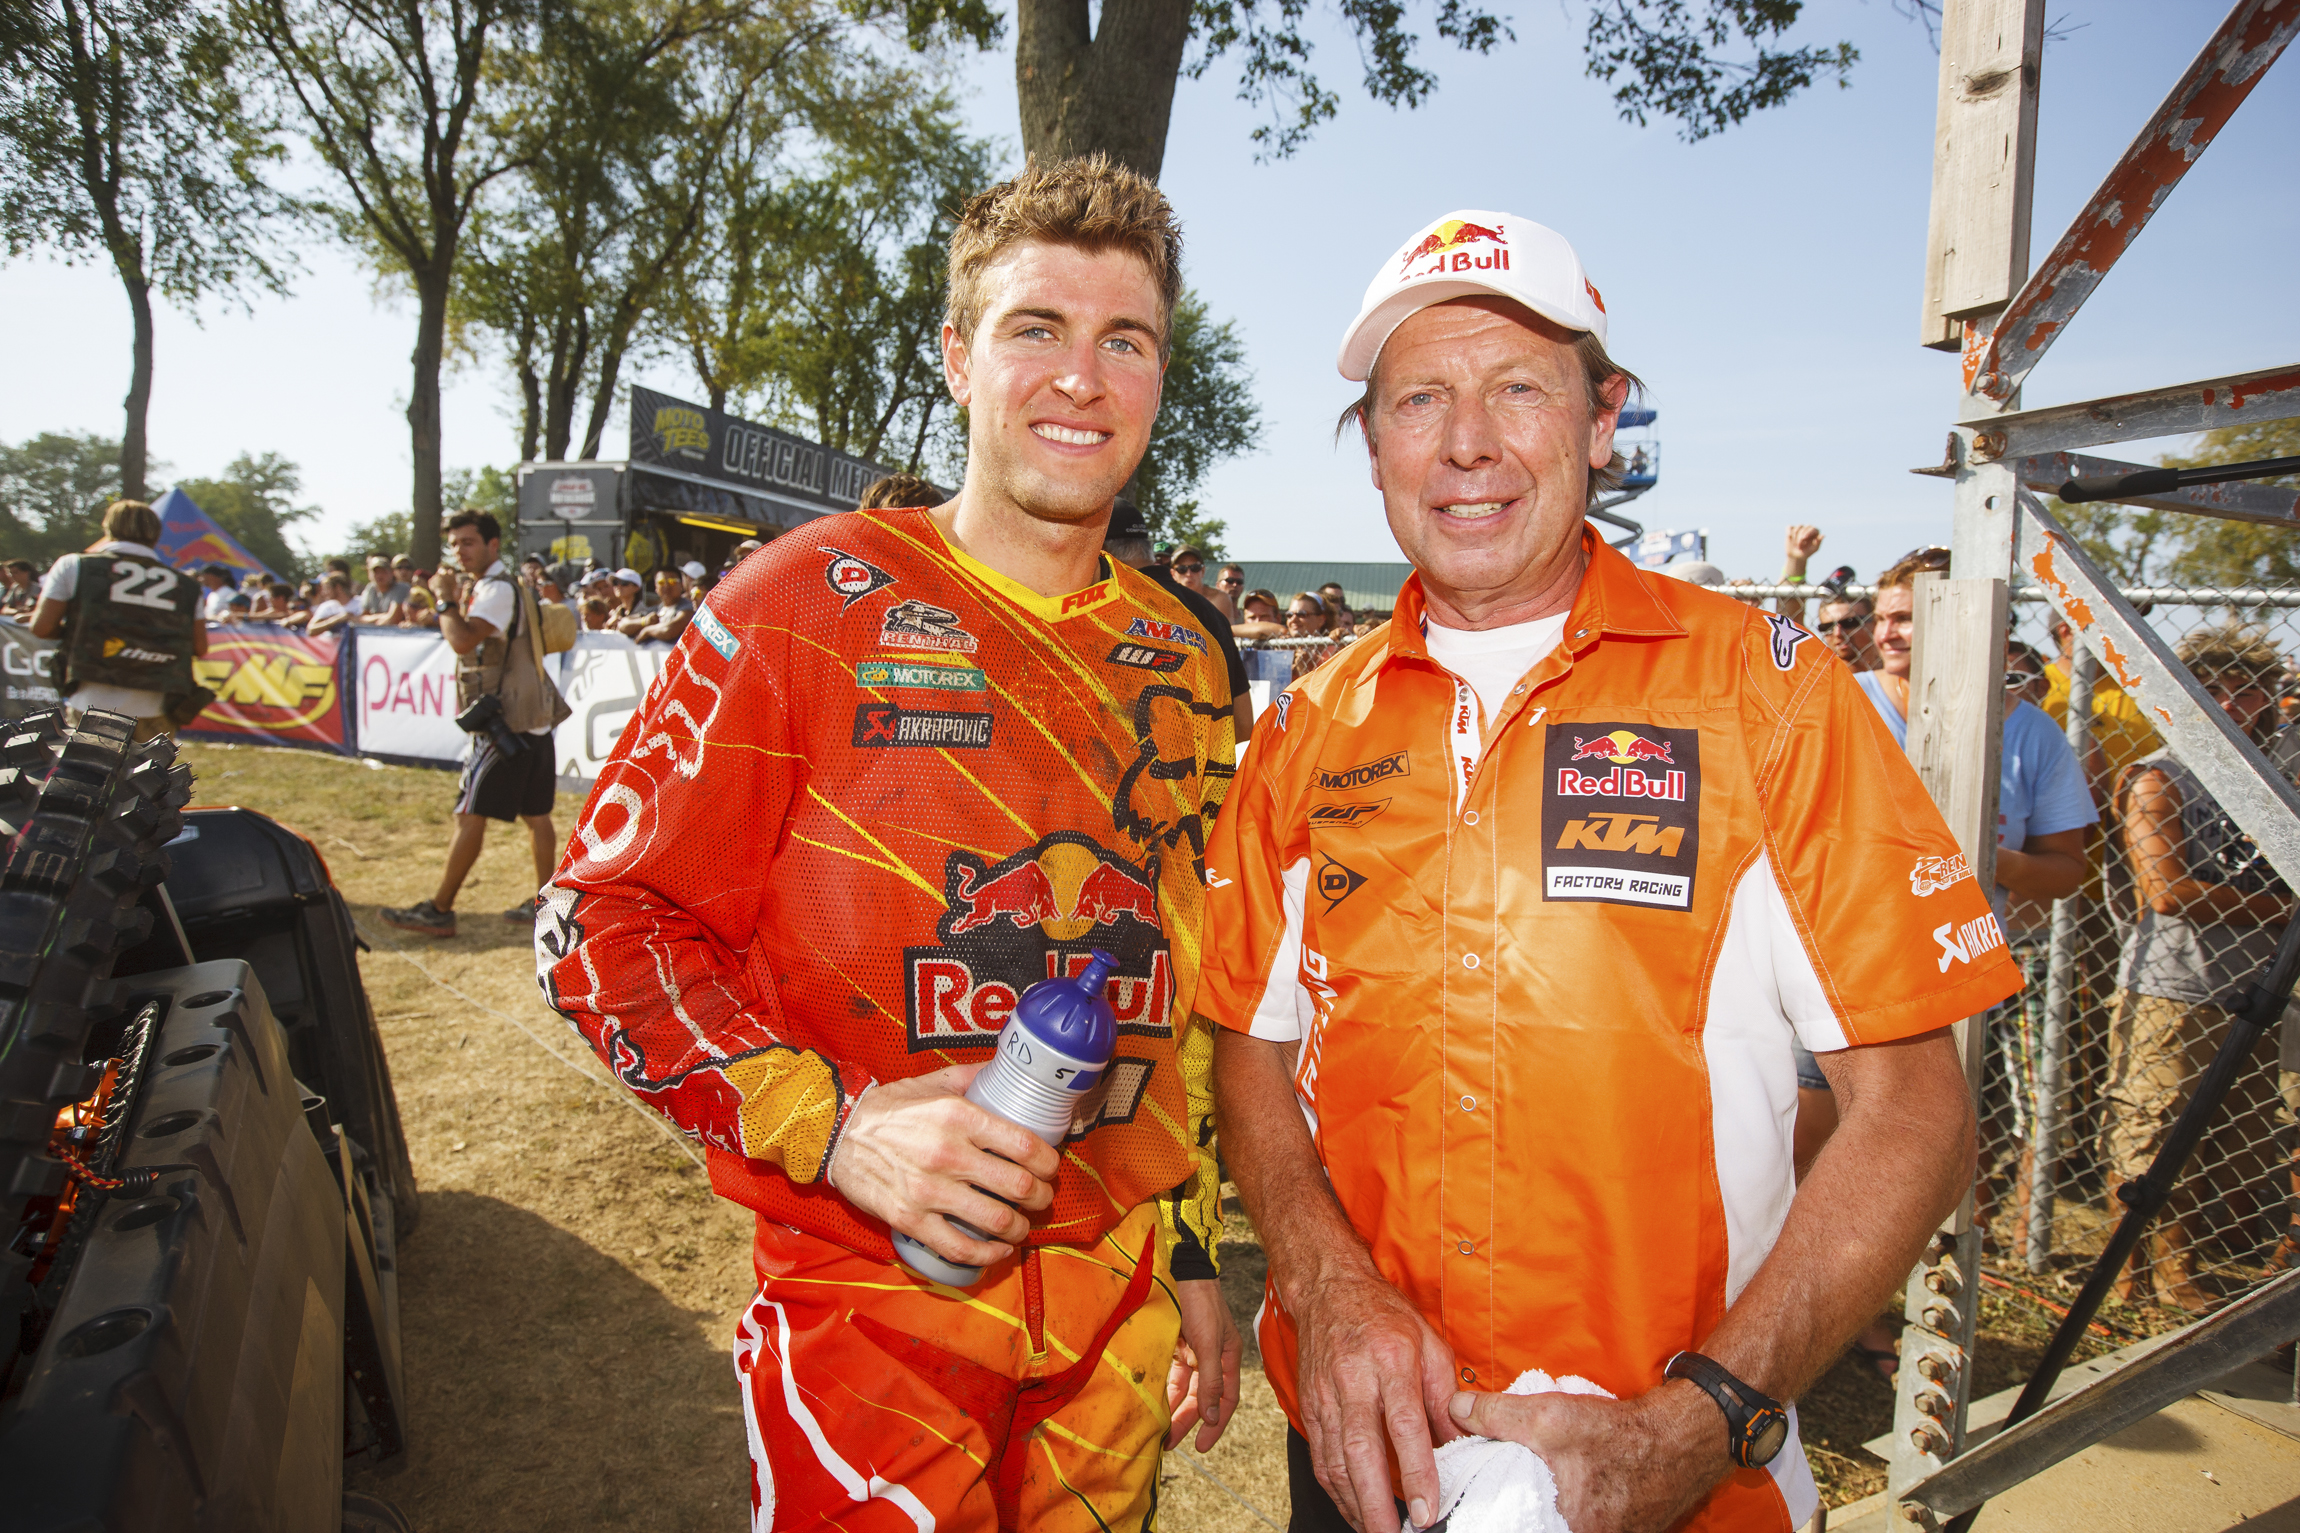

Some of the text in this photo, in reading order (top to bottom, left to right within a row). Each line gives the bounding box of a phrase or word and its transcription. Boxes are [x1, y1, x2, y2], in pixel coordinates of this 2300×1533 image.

[1452, 248, 1510, 273] Bull
[654, 407, 705, 434] MOTO
[663, 427, 711, 452] TEES
[723, 424, 824, 496] OFFICIAL
[110, 560, 178, 612] 22
[1060, 583, 1110, 615] FOX
[883, 629, 977, 651] RENTHAL
[1123, 617, 1188, 645] AMA
[192, 653, 333, 708] FMF
[893, 667, 977, 688] MOTOREX
[1558, 767, 1686, 801] Red Bull
[1555, 812, 1686, 857] KTM
[1324, 874, 1348, 890] D
[1554, 875, 1624, 890] FACTORY
[1006, 1030, 1032, 1065] RD
